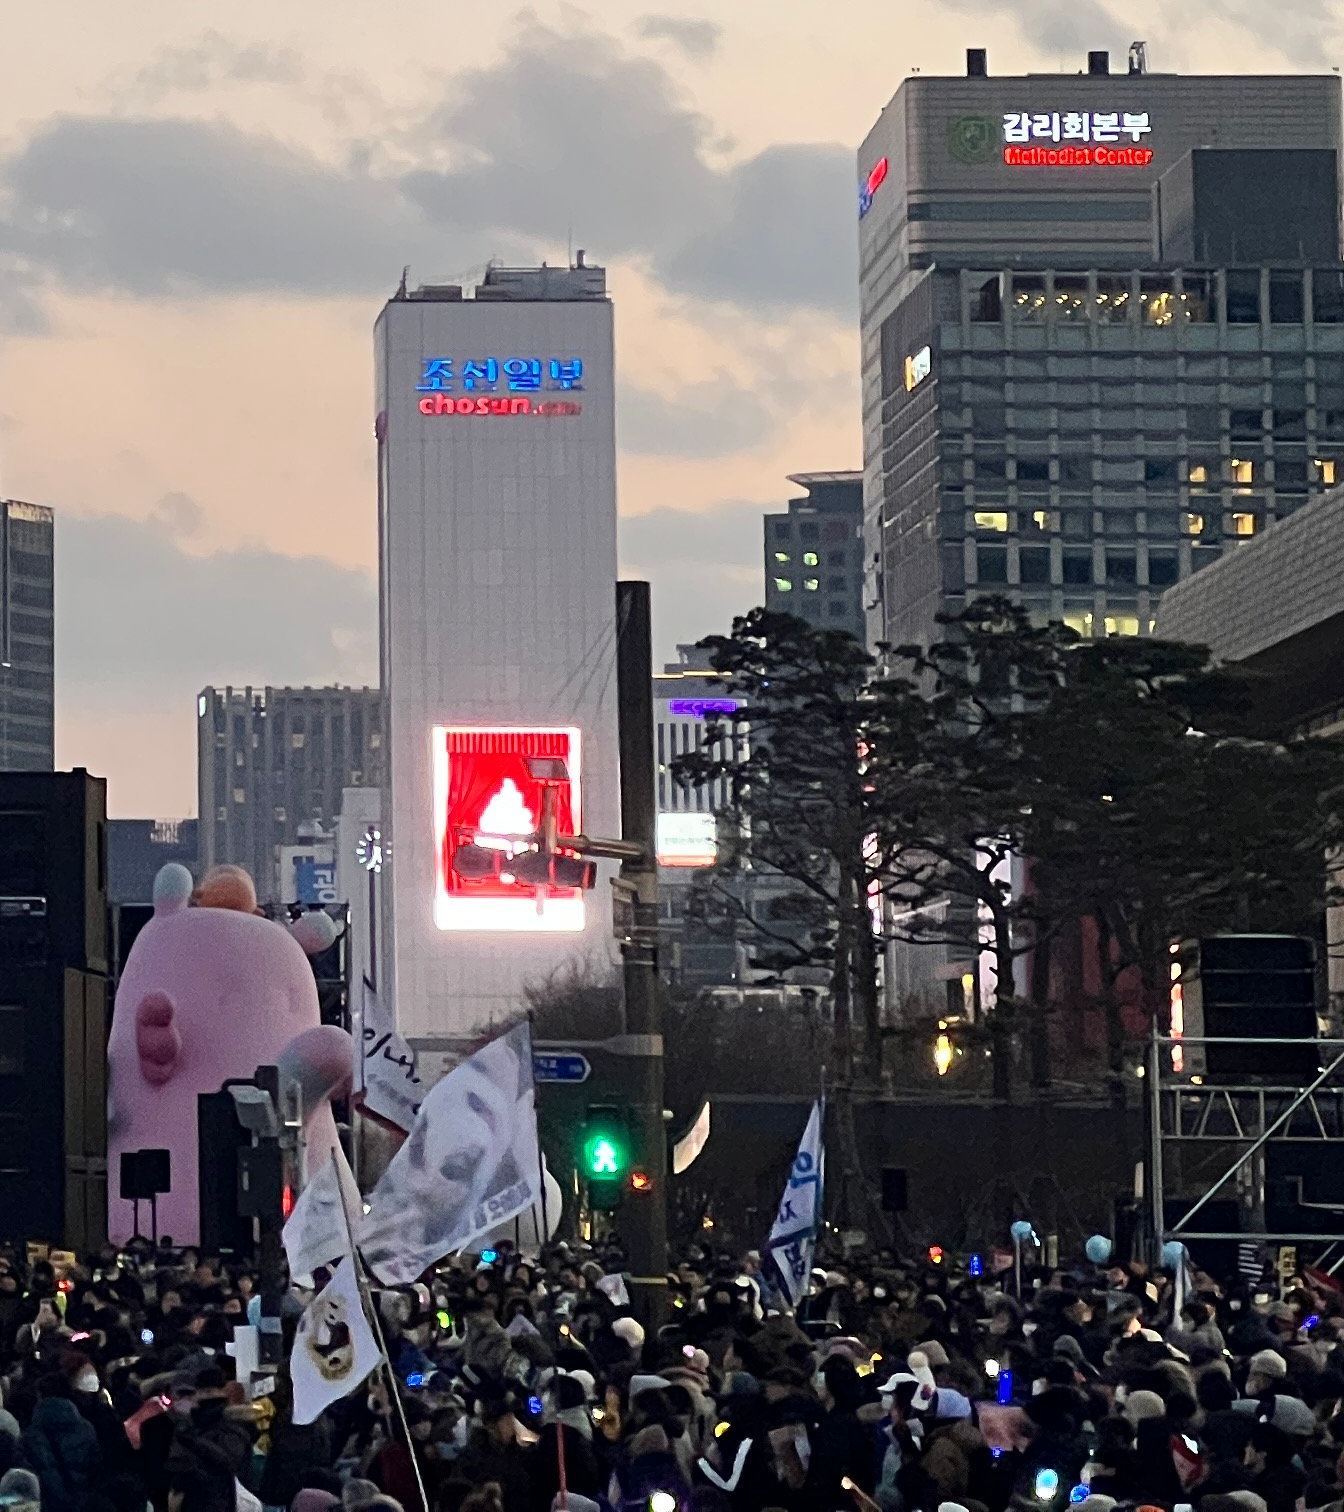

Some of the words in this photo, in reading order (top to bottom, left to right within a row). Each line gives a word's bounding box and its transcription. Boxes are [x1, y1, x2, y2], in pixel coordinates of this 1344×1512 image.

[1003, 112, 1151, 142] 감리회본부
[1004, 146, 1091, 165] Methodist
[1094, 146, 1153, 165] Center
[415, 358, 585, 392] 조선일보
